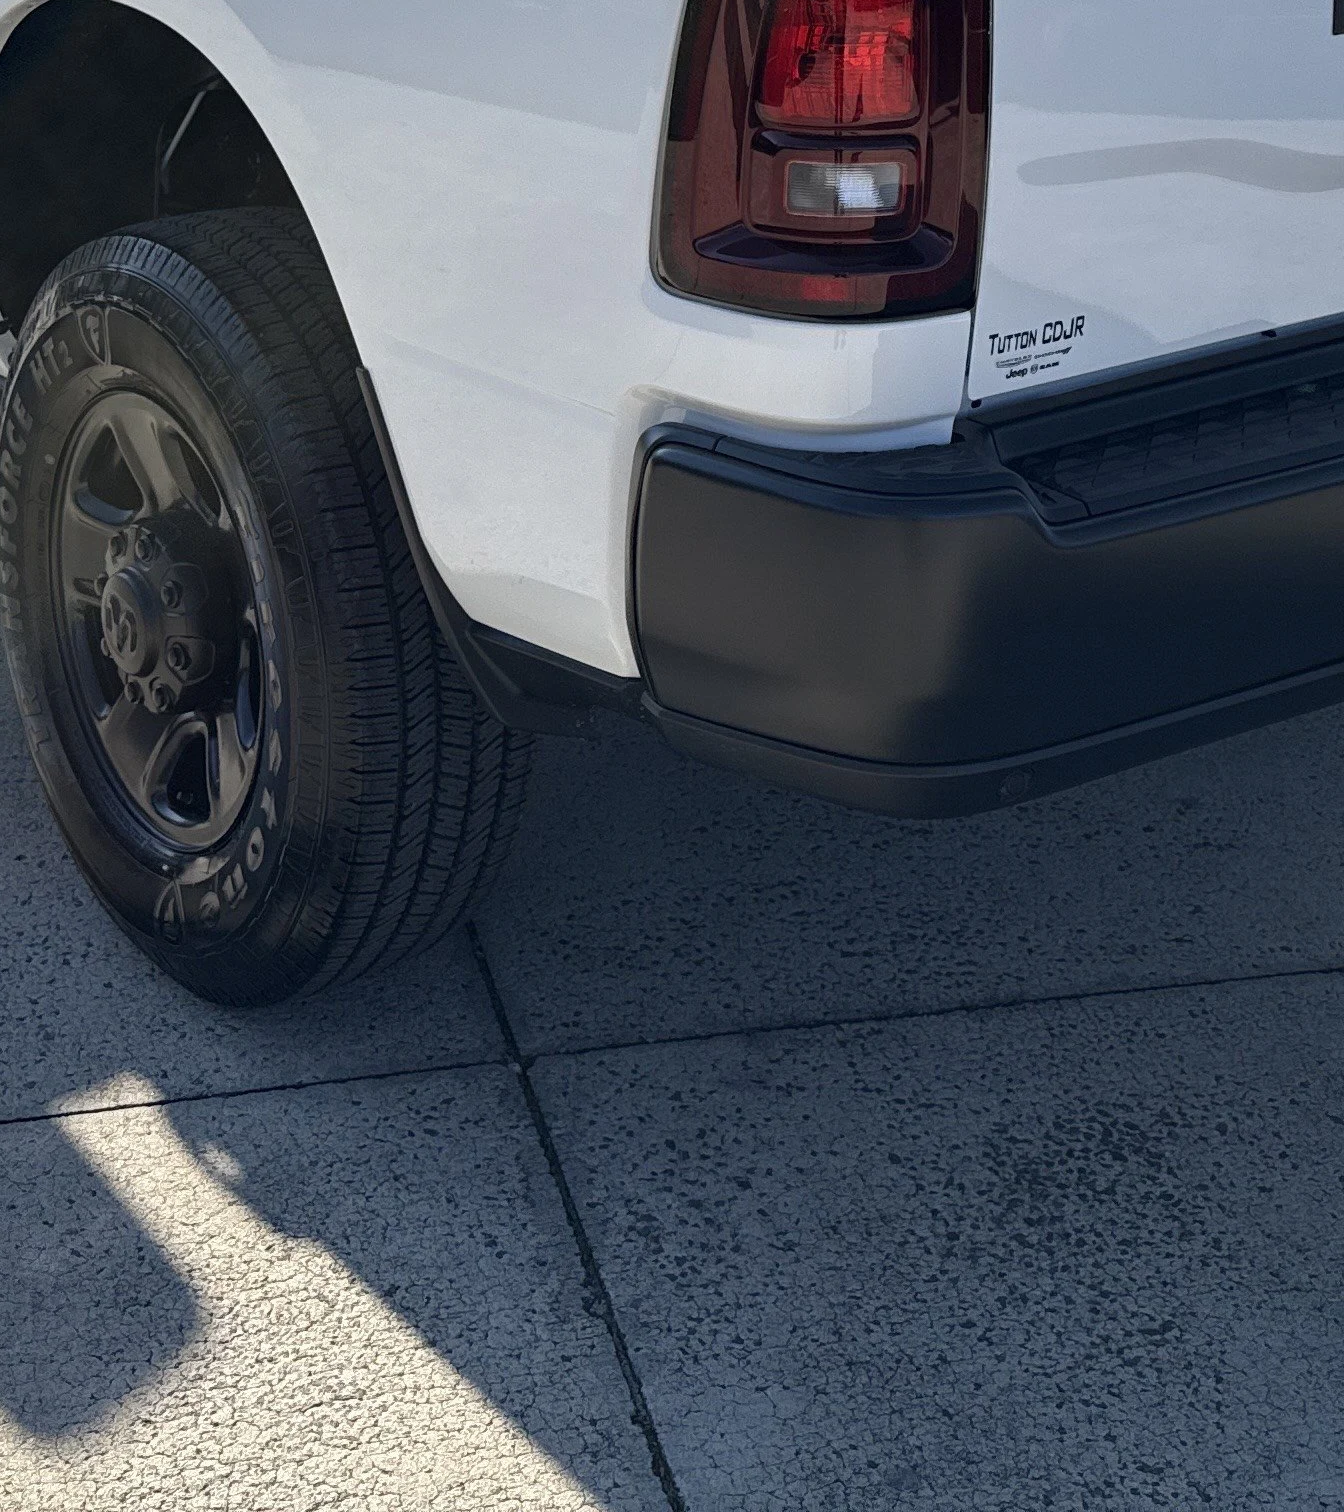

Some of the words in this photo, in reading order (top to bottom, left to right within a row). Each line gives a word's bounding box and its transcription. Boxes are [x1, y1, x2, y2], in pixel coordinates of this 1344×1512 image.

[988, 329, 1038, 356] TUTTON
[1042, 315, 1085, 345] CDJR
[1005, 367, 1028, 379] Jeep
